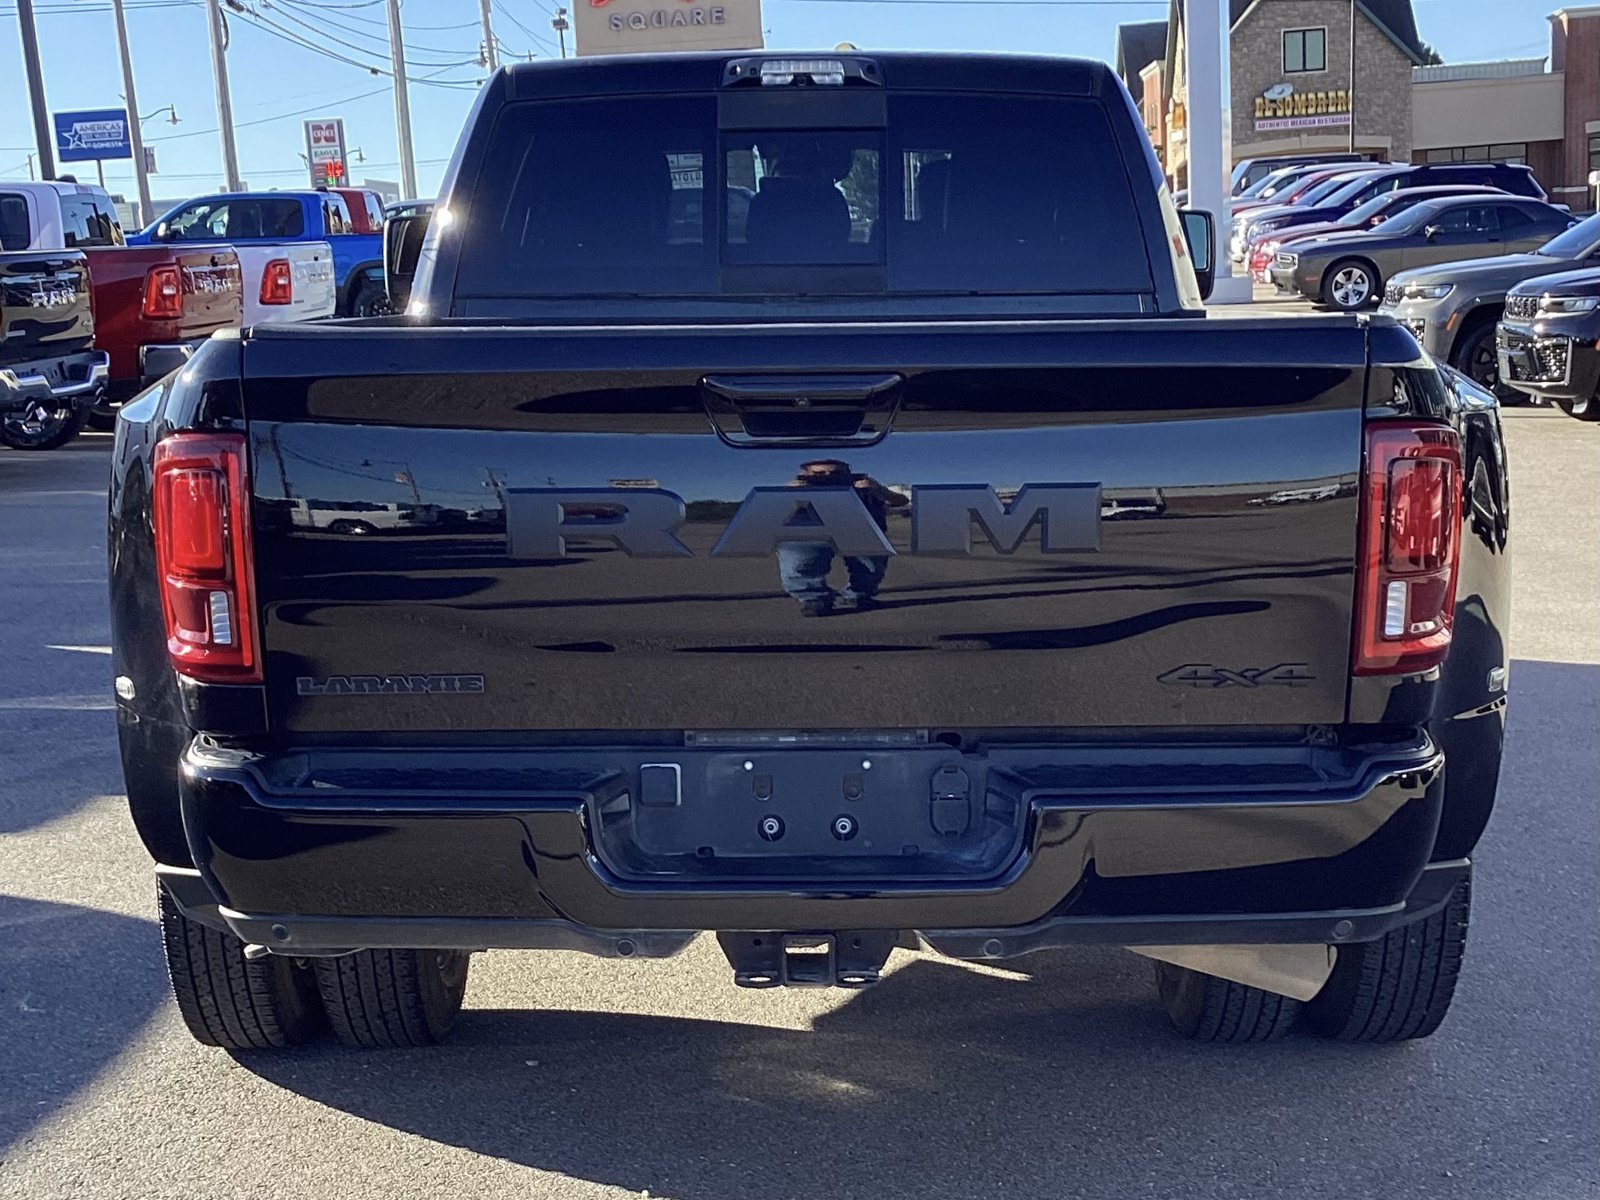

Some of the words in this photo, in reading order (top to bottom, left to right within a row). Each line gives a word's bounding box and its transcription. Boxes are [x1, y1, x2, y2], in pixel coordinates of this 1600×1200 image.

[609, 6, 727, 31] SQUARE
[1257, 120, 1290, 129] AUTHENTIC
[1290, 118, 1316, 127] MEXICAN
[1317, 116, 1351, 125] RESTAURAN
[313, 129, 335, 138] CENEX
[504, 482, 1102, 557] RAM
[296, 675, 485, 695] LARAMIE
